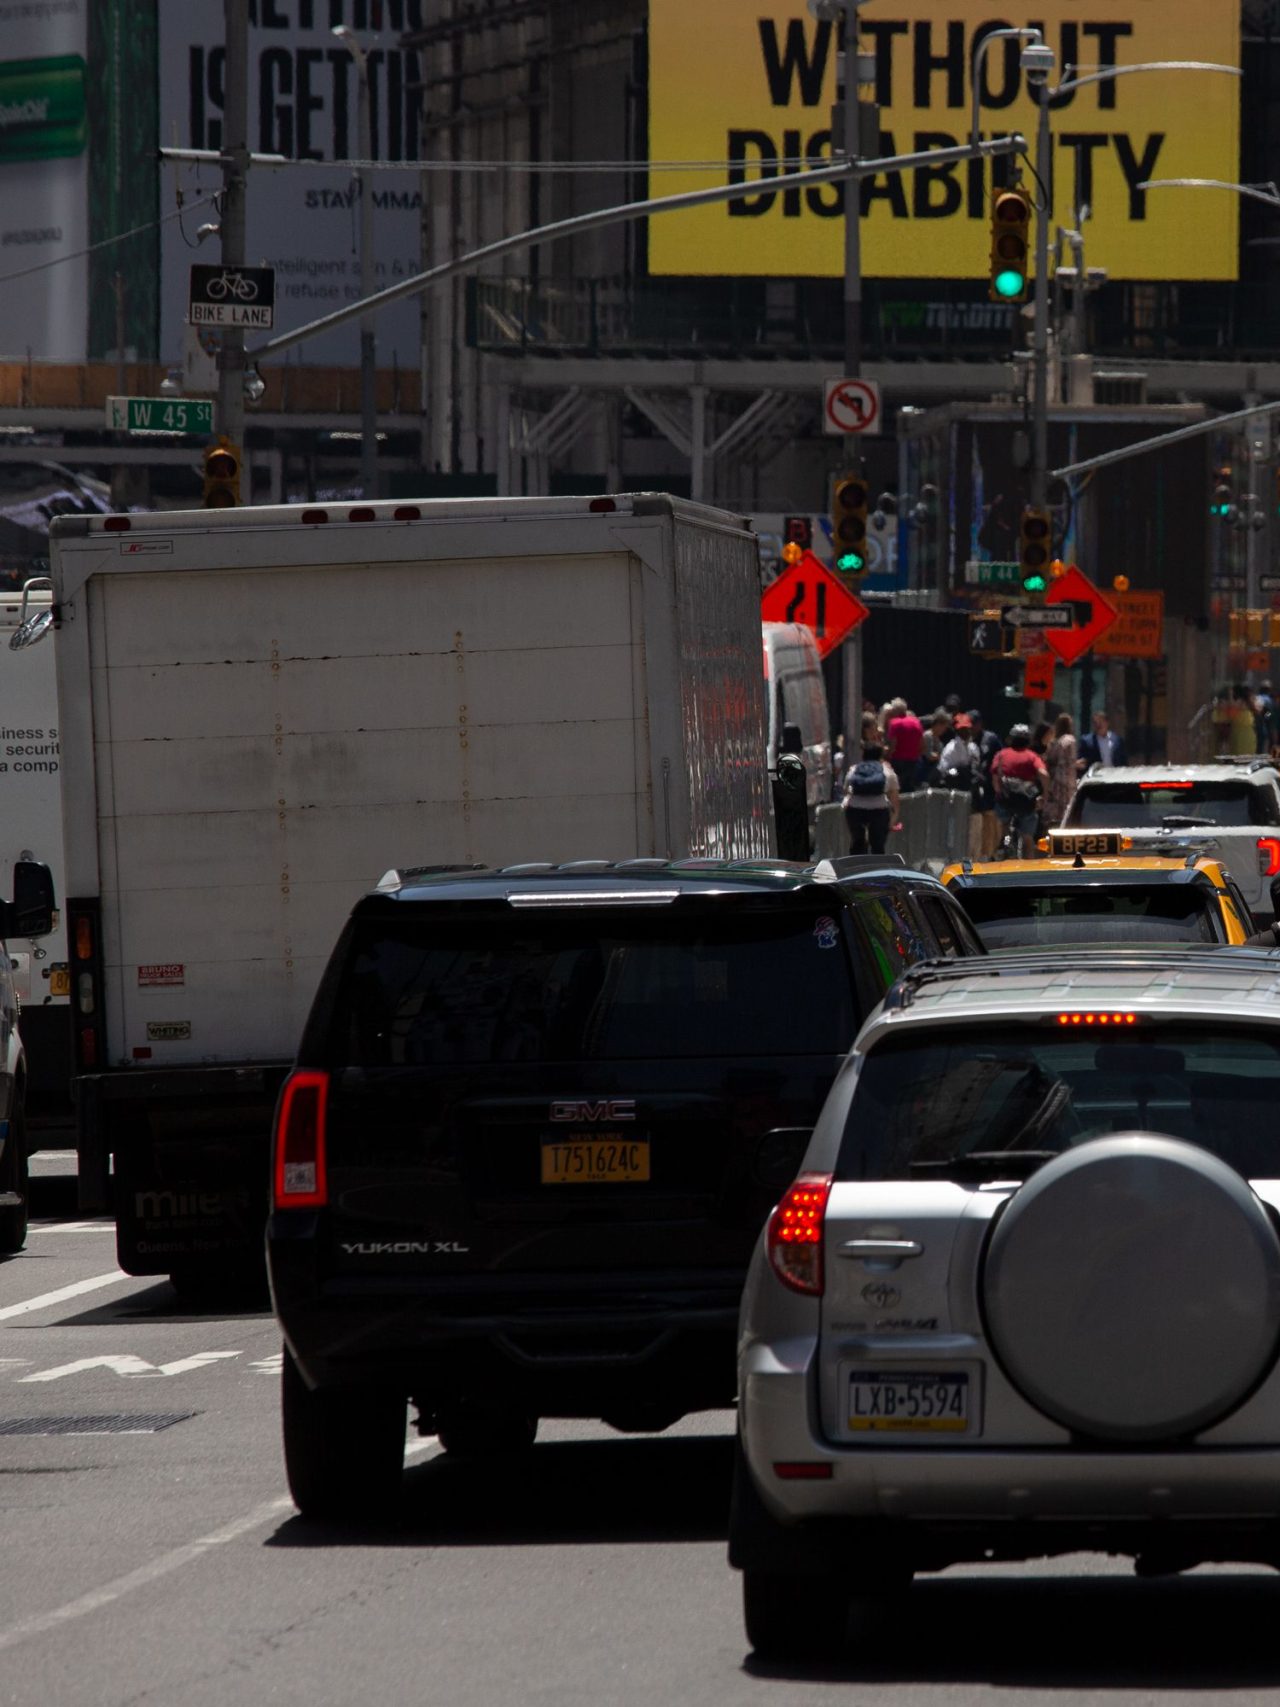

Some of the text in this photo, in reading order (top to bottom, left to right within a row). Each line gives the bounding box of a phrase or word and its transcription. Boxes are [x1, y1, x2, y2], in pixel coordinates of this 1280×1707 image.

[305, 190, 354, 209] STAY
[194, 307, 269, 324] BIKE LANE
[134, 403, 210, 428] W 45 St
[13, 762, 58, 775] comp
[148, 1026, 190, 1036] WHITING
[550, 1100, 636, 1121] GMC
[552, 1145, 639, 1173] T751624C
[341, 1242, 470, 1254] YUKON XL
